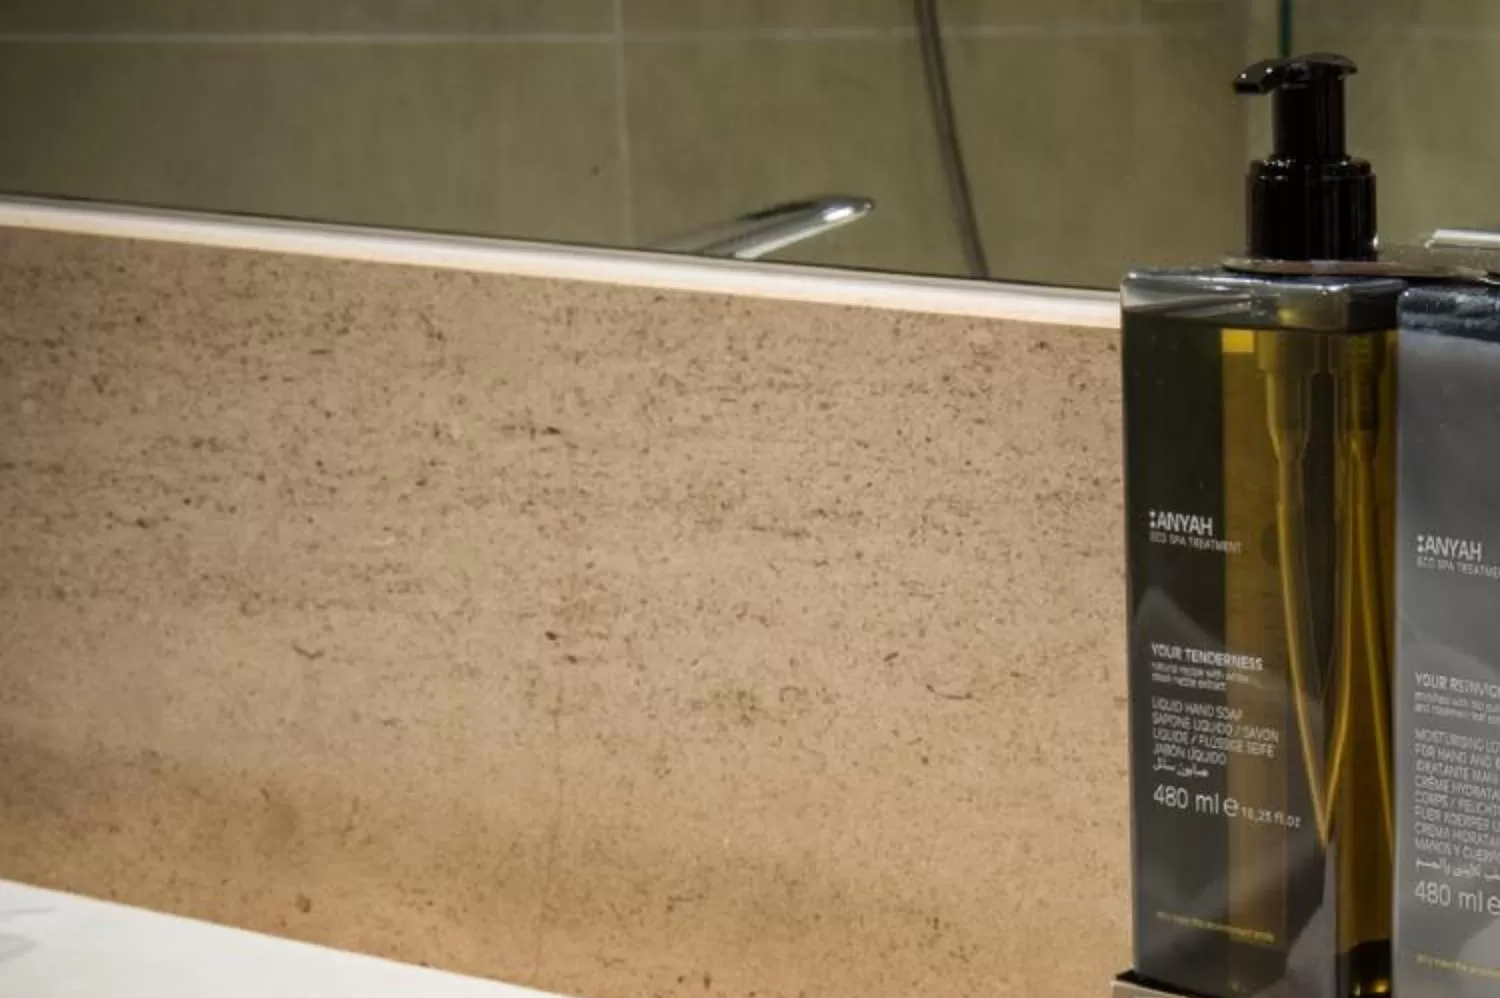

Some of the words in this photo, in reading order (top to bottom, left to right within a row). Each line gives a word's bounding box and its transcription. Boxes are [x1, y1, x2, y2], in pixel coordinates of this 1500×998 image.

[1151, 642, 1182, 660] YOUR
[1184, 648, 1264, 671] TENDERNESS
[1415, 671, 1449, 689] YOUR
[1151, 695, 1183, 713] LIQUID
[1185, 701, 1214, 717] HAND
[1151, 711, 1191, 730] SAPONE
[1414, 743, 1436, 758] FOR
[1438, 747, 1468, 764] HAND
[1470, 753, 1493, 769] AND
[1153, 783, 1189, 810] 480
[1195, 792, 1219, 815] ml
[1414, 878, 1452, 907] 480
[1458, 888, 1484, 913] ml
